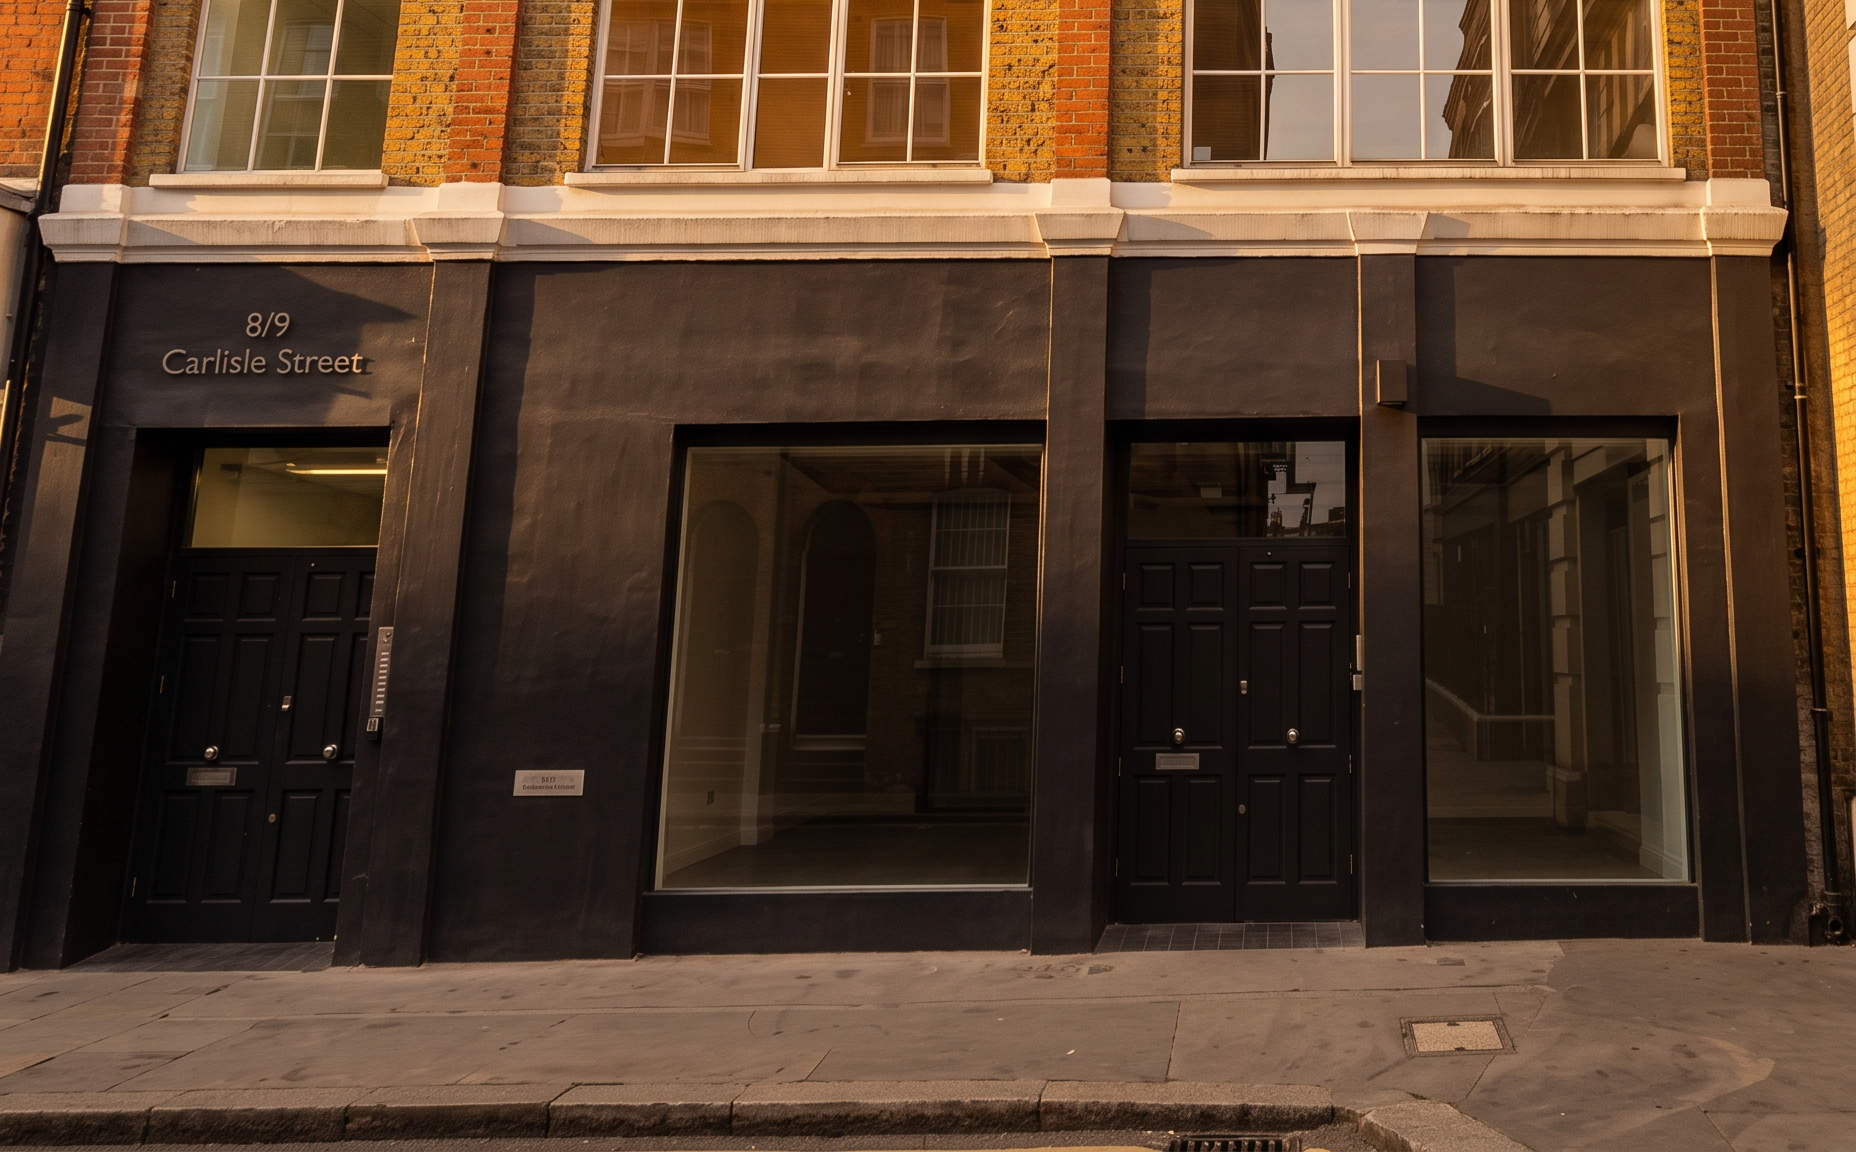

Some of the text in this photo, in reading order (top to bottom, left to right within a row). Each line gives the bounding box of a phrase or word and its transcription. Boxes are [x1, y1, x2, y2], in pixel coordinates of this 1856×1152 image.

[245, 312, 290, 337] 8/9
[162, 348, 363, 374] Carlisle Street
